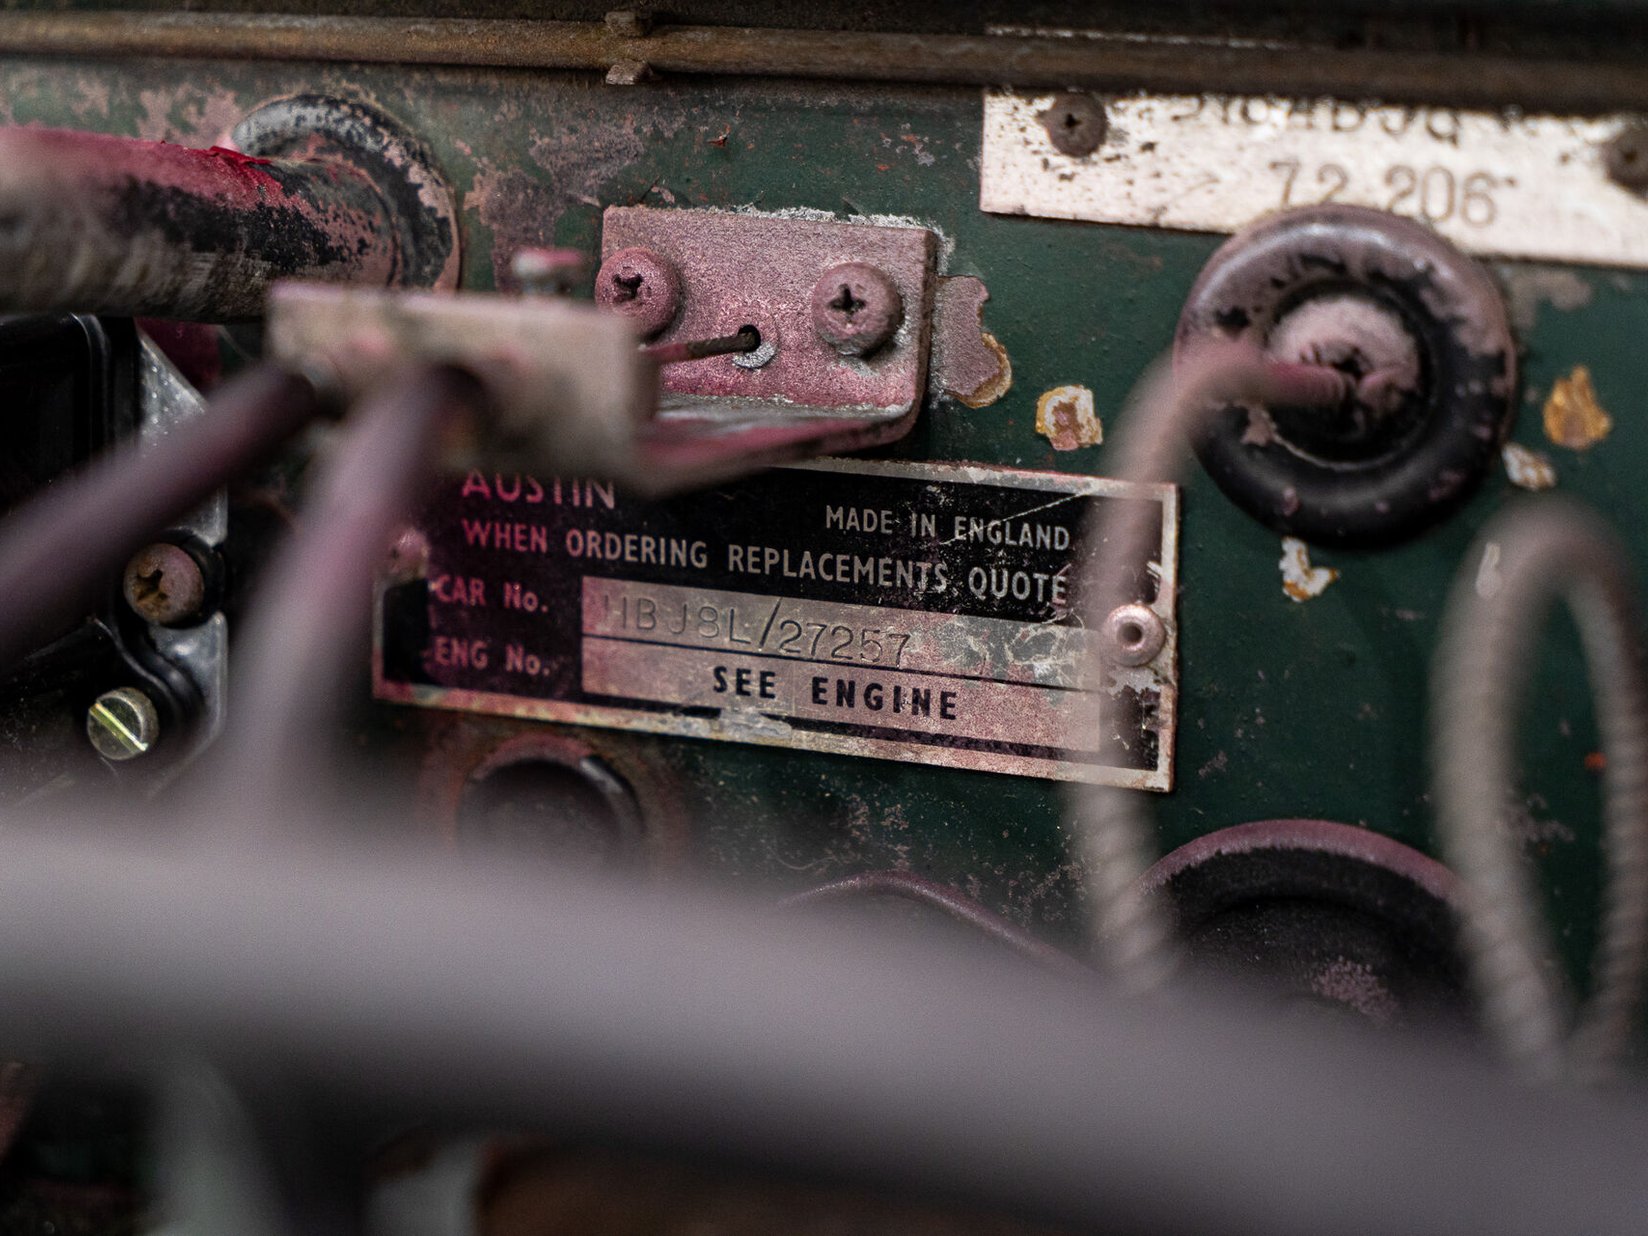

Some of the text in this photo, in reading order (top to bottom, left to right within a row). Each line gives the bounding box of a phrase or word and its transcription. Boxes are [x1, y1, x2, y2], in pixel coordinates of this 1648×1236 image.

[462, 469, 615, 510] AUSTIN
[825, 505, 1070, 550] MADE IN ENGLAND
[461, 517, 1067, 605] WHEN ORDERING REPLACEMENTS QUOTE
[436, 574, 486, 606] CAR
[503, 581, 548, 613] No.
[434, 635, 957, 720] ENG No. SEE ENGINE
